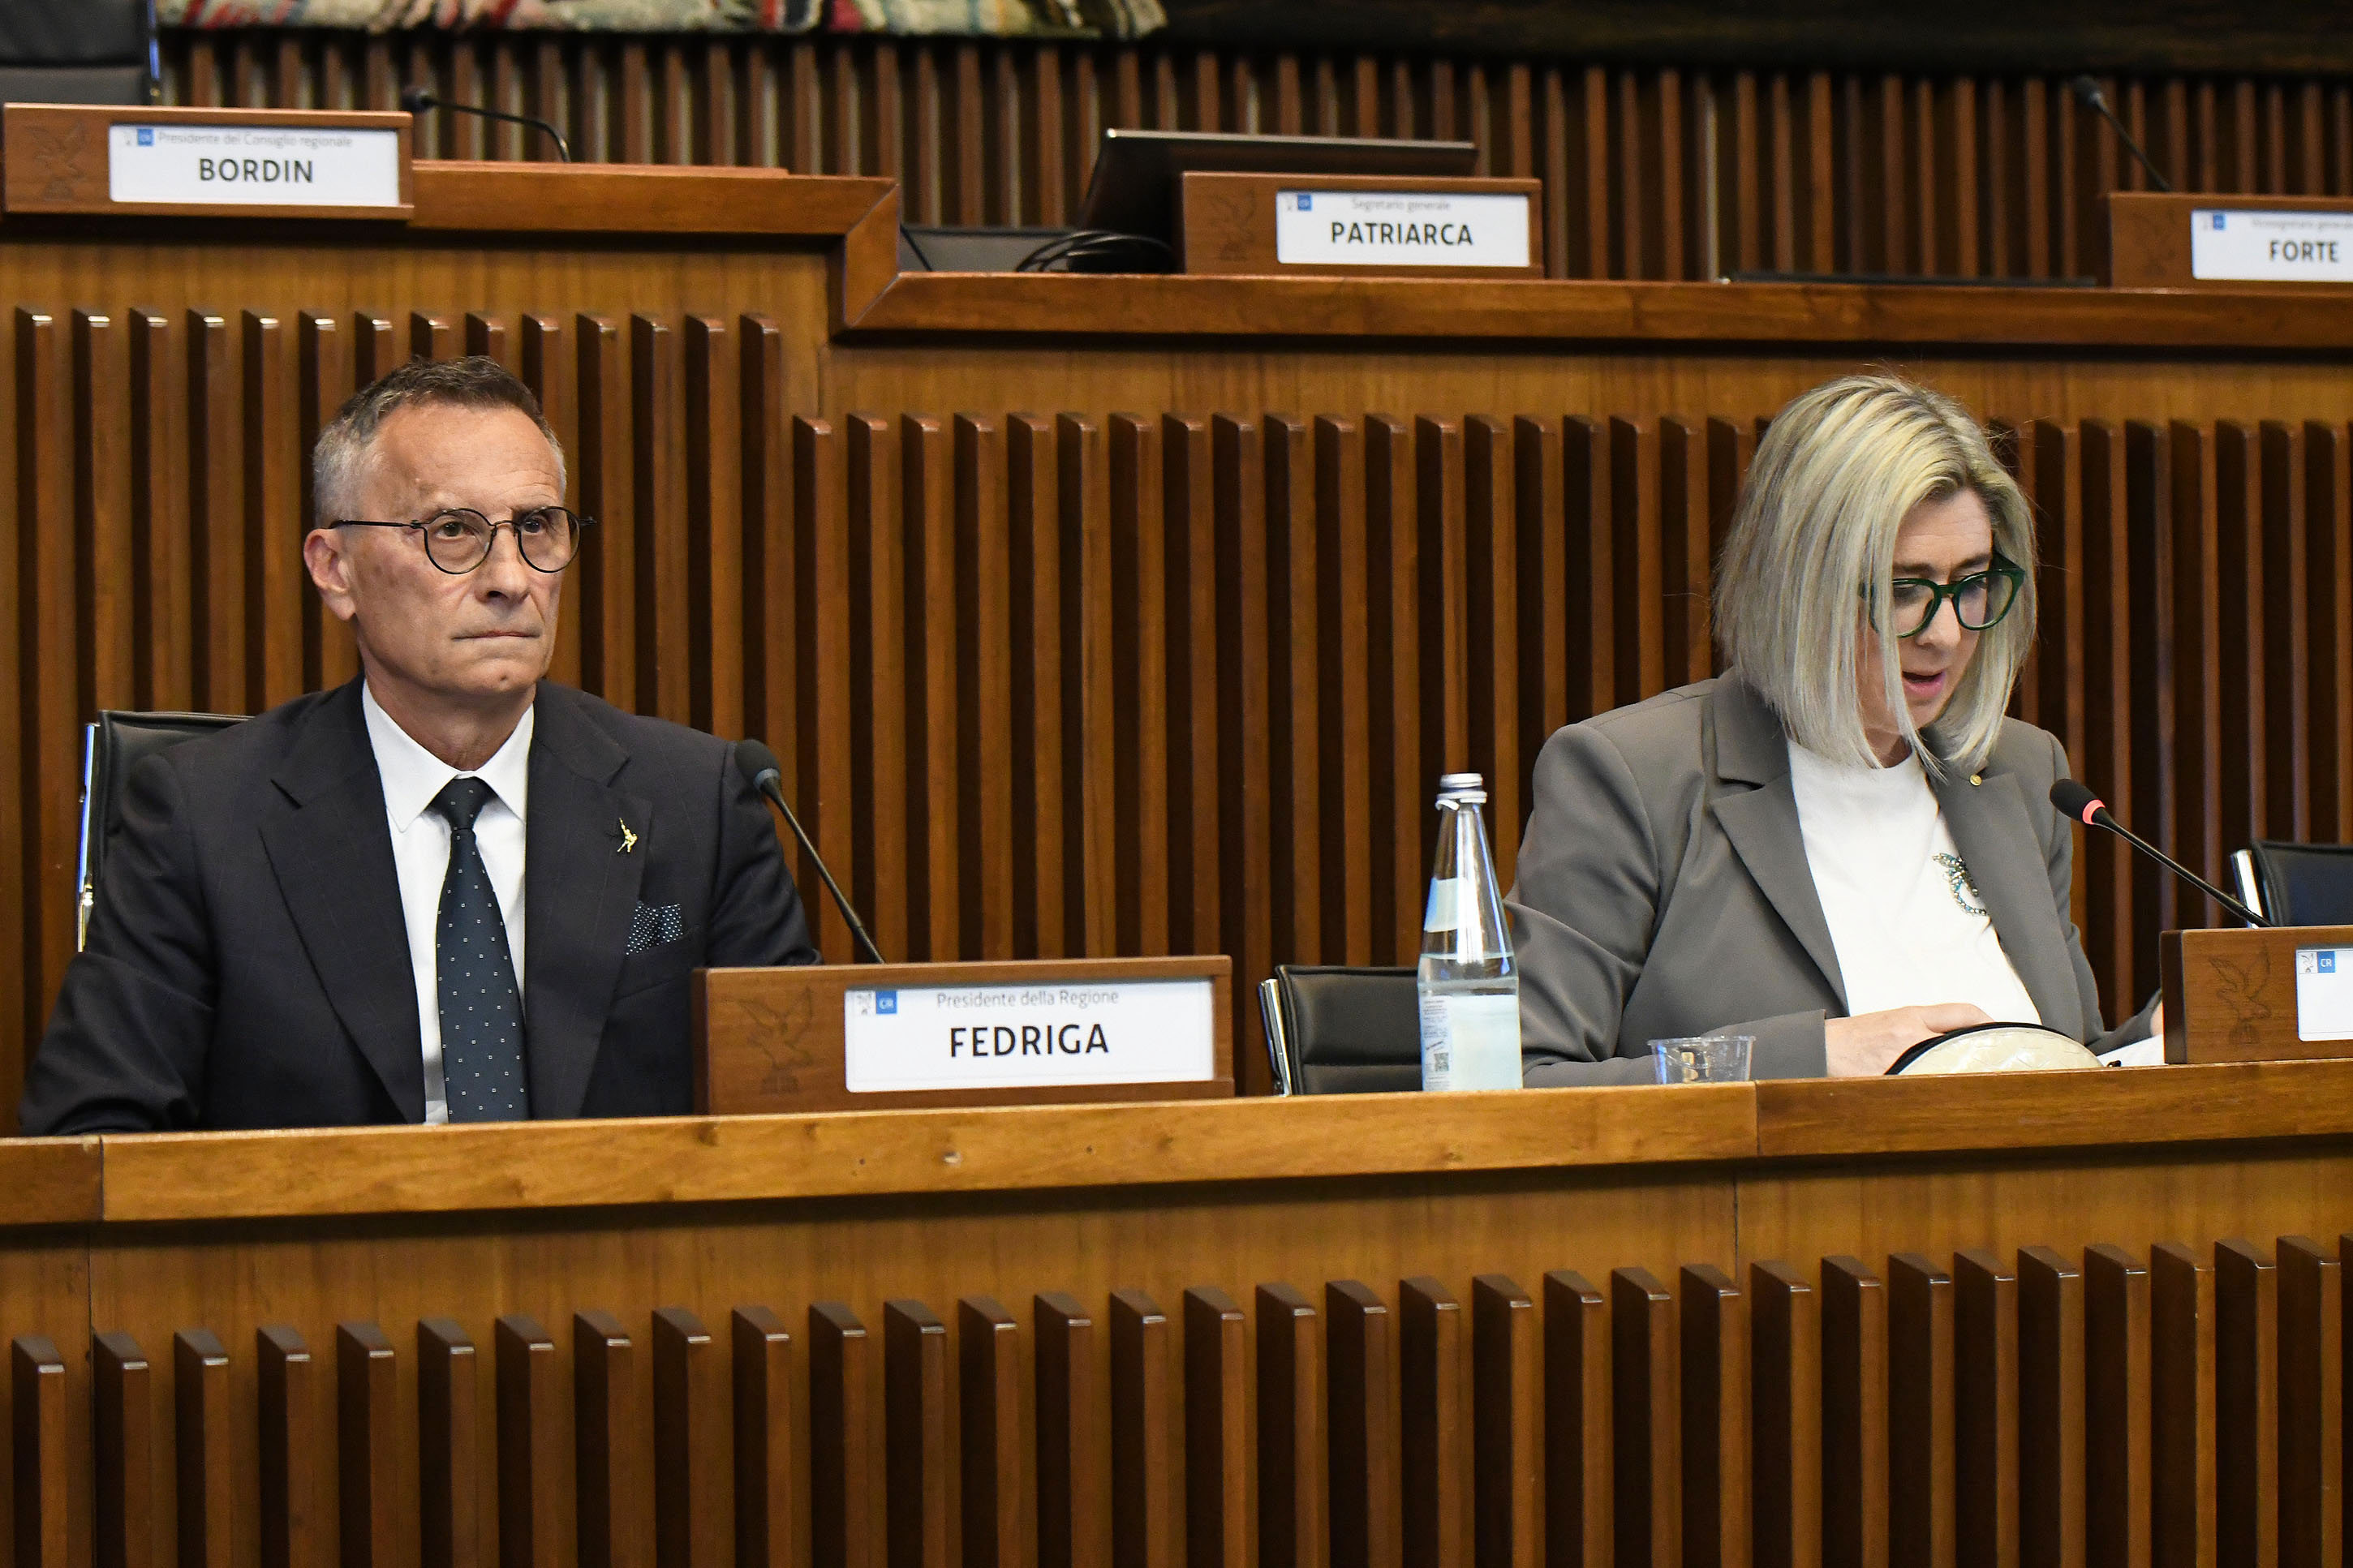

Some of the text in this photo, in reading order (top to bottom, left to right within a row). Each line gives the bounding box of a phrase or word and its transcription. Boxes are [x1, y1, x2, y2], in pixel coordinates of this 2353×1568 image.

[158, 131, 220, 145] Presidente
[243, 133, 295, 149] Consiglio
[300, 135, 352, 149] regionale
[200, 157, 313, 183] BORDIN
[1331, 221, 1473, 246] PATRIARCA
[2269, 240, 2339, 263] FORTE
[2321, 958, 2333, 968] CR
[937, 989, 1119, 1008] Presidente della Regione
[951, 1024, 1109, 1058] FEDRIGA
